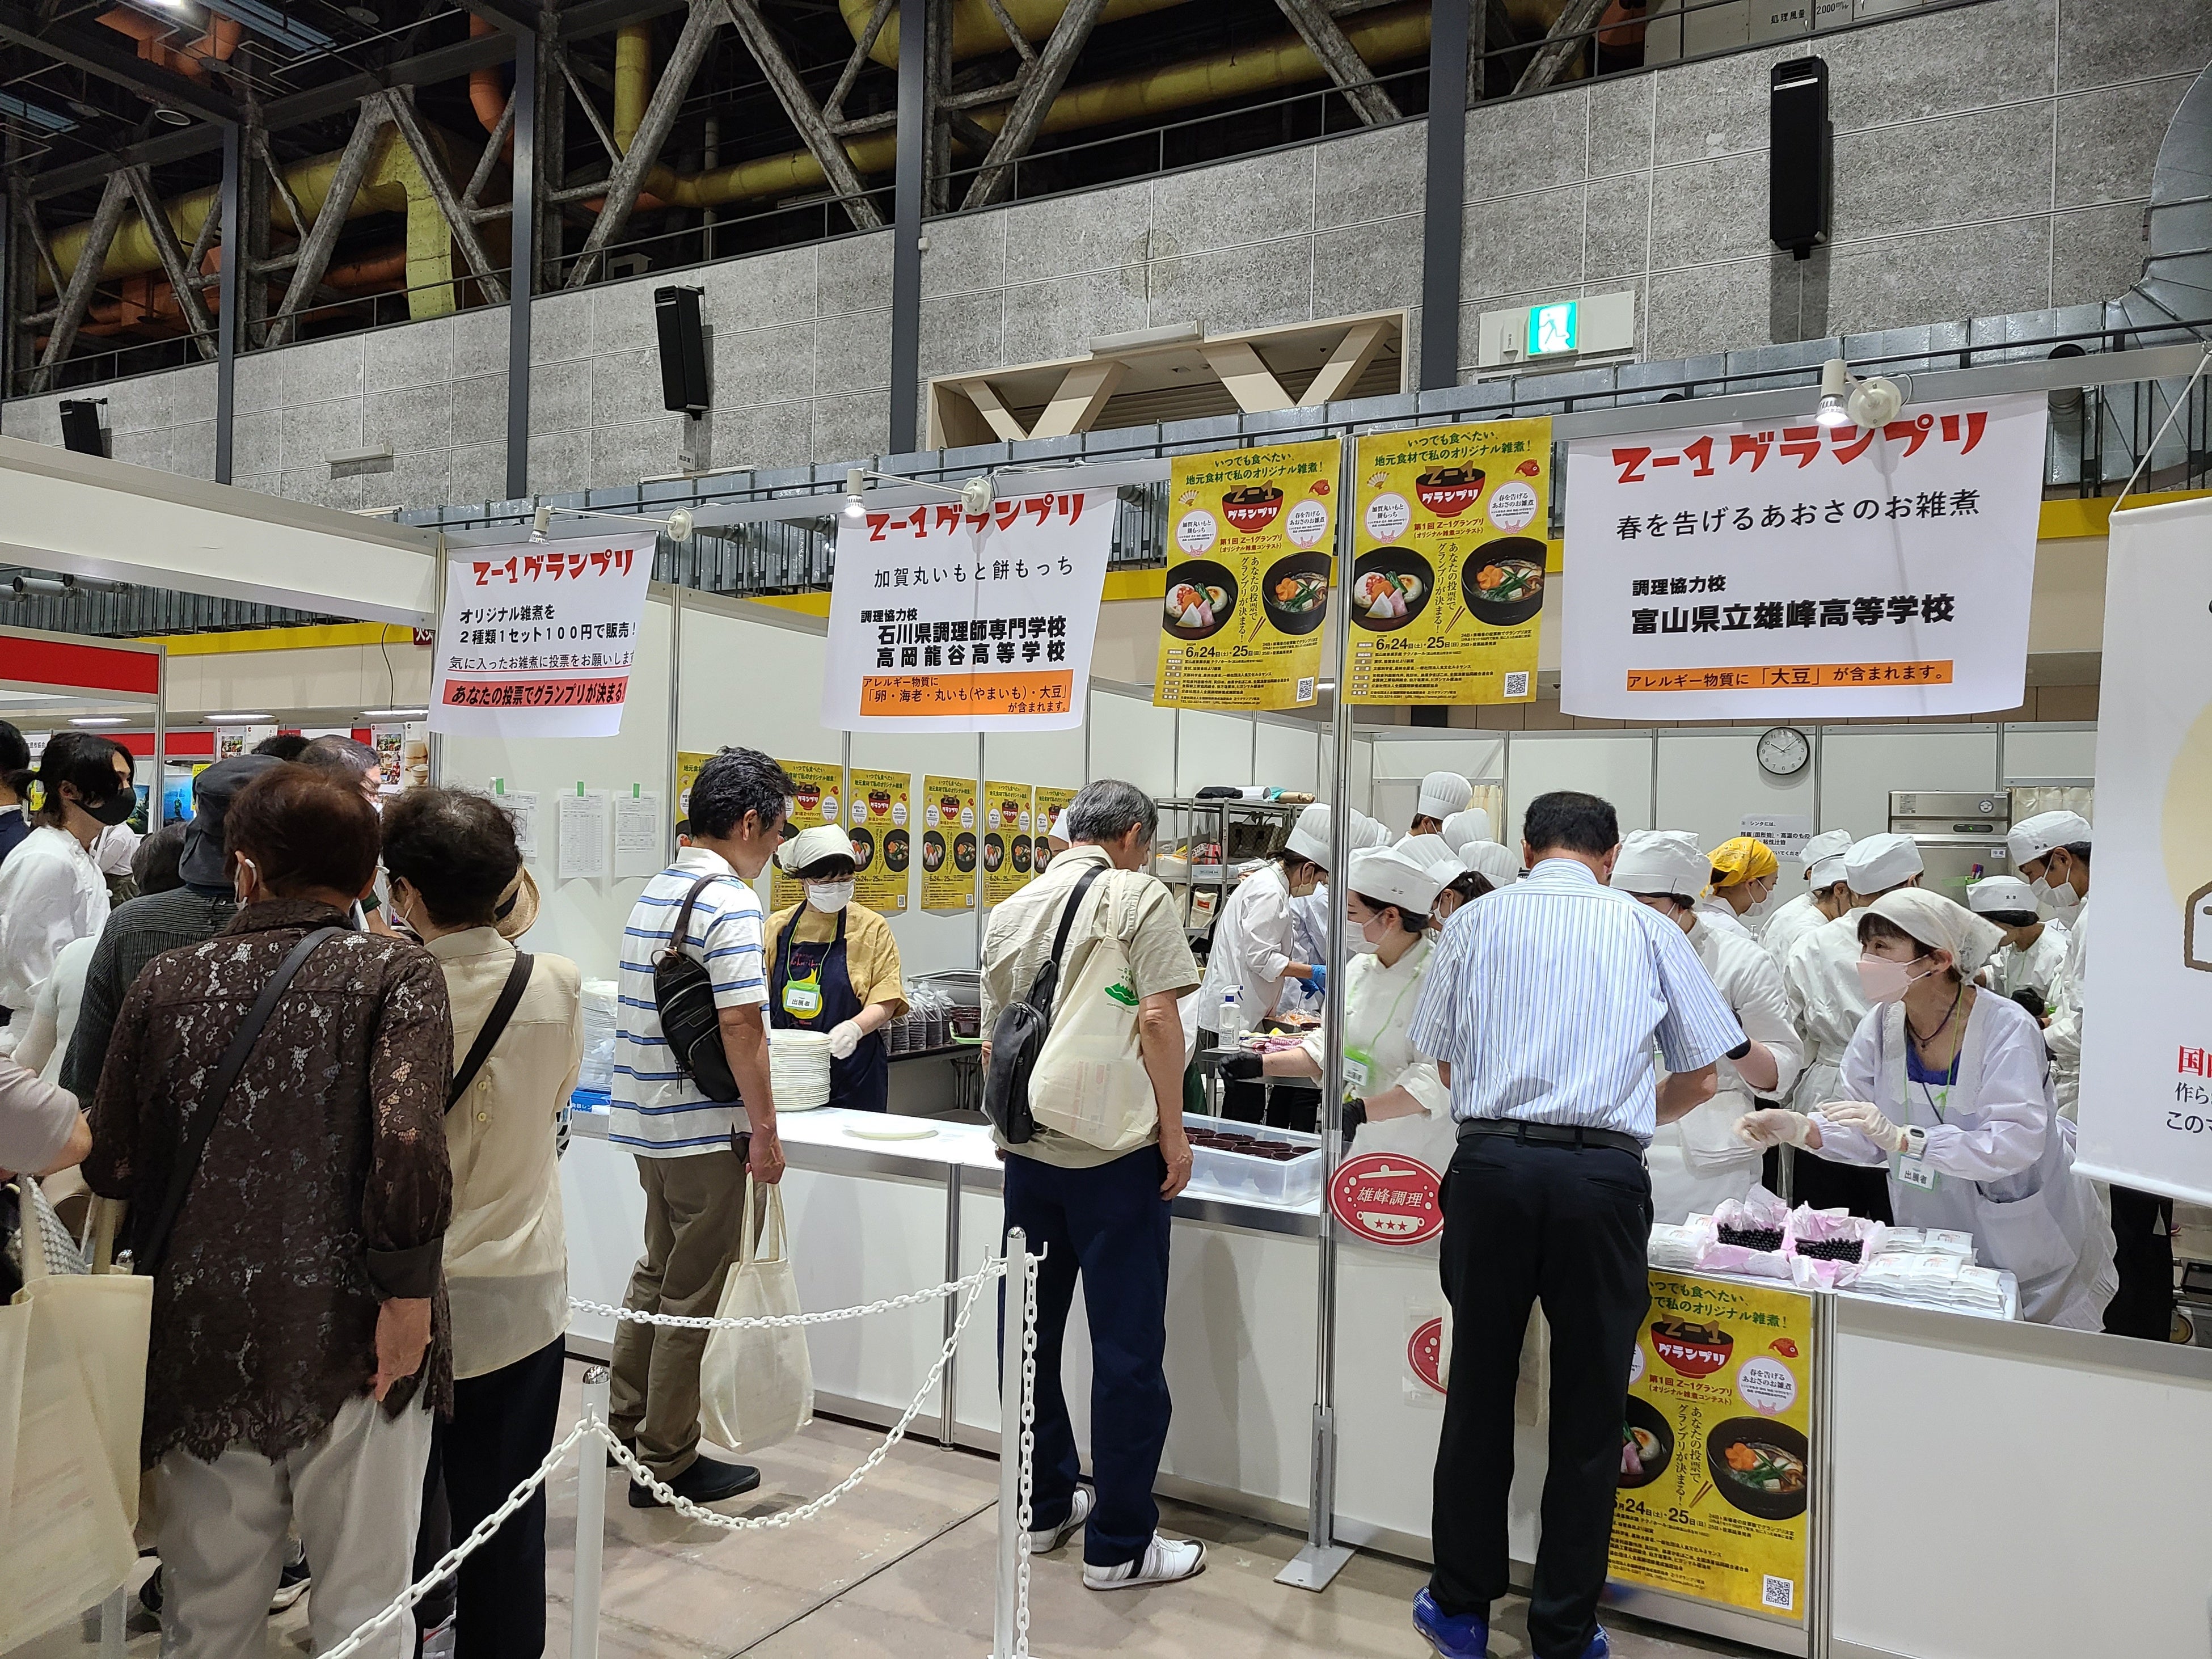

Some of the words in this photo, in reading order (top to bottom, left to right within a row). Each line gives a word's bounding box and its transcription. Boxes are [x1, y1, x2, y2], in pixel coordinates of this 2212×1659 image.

[1771, 9, 1805, 24] 処理風量
[1375, 440, 1531, 467] 地元食材で私のオリジナル雑煮!
[1186, 462, 1323, 486] 地元食材で私のオリジナル雑煮!
[1425, 459, 1475, 485] Z-1
[1230, 479, 1274, 503] Z-1
[1422, 488, 1479, 504] グランプリ
[1227, 506, 1277, 521] グランプリ
[1413, 522, 1434, 531] 第1回
[1437, 518, 1484, 529] Z-1グランプリ
[1616, 487, 1981, 541] 春を告げるあおさのお雑煮
[1220, 537, 1238, 545] 第1回
[1240, 534, 1282, 543] Z-1グランプリ
[472, 548, 634, 586] Z-1グランプリ
[874, 555, 1073, 588] 加賀丸いもと餅もっち
[1447, 542, 1458, 610] あなたの投票で
[1249, 556, 1259, 620] あなたの投票で
[1434, 543, 1447, 634] グランプリが決まる!
[1632, 574, 1726, 596] 調理協力校
[1238, 557, 1249, 643] グランプリが決まる!
[459, 604, 555, 624] オリジナル雑煮を
[860, 608, 918, 623] 調理協力校
[1631, 593, 1955, 635] 富山県立雄峰高等学校
[877, 616, 1066, 645] 石川県調理師専門学校
[876, 639, 1066, 669] 高岡龍谷高等学校
[863, 676, 938, 687] アレルギー物質に
[1008, 700, 1069, 714] が含まれます。
[2179, 1045, 2212, 1078] 国
[2175, 1082, 2212, 1104] 作ら
[1356, 1187, 1424, 1208] 雄峰調理
[1650, 1296, 1787, 1328] で私のオリジナル雑煮!
[1662, 1314, 1721, 1344] Z-1
[1658, 1343, 1725, 1366] グランプリ
[1649, 1374, 1673, 1386] 第1回
[1677, 1379, 1732, 1396] Z-1グランプリ
[1690, 1407, 1702, 1483] あなたの投票で
